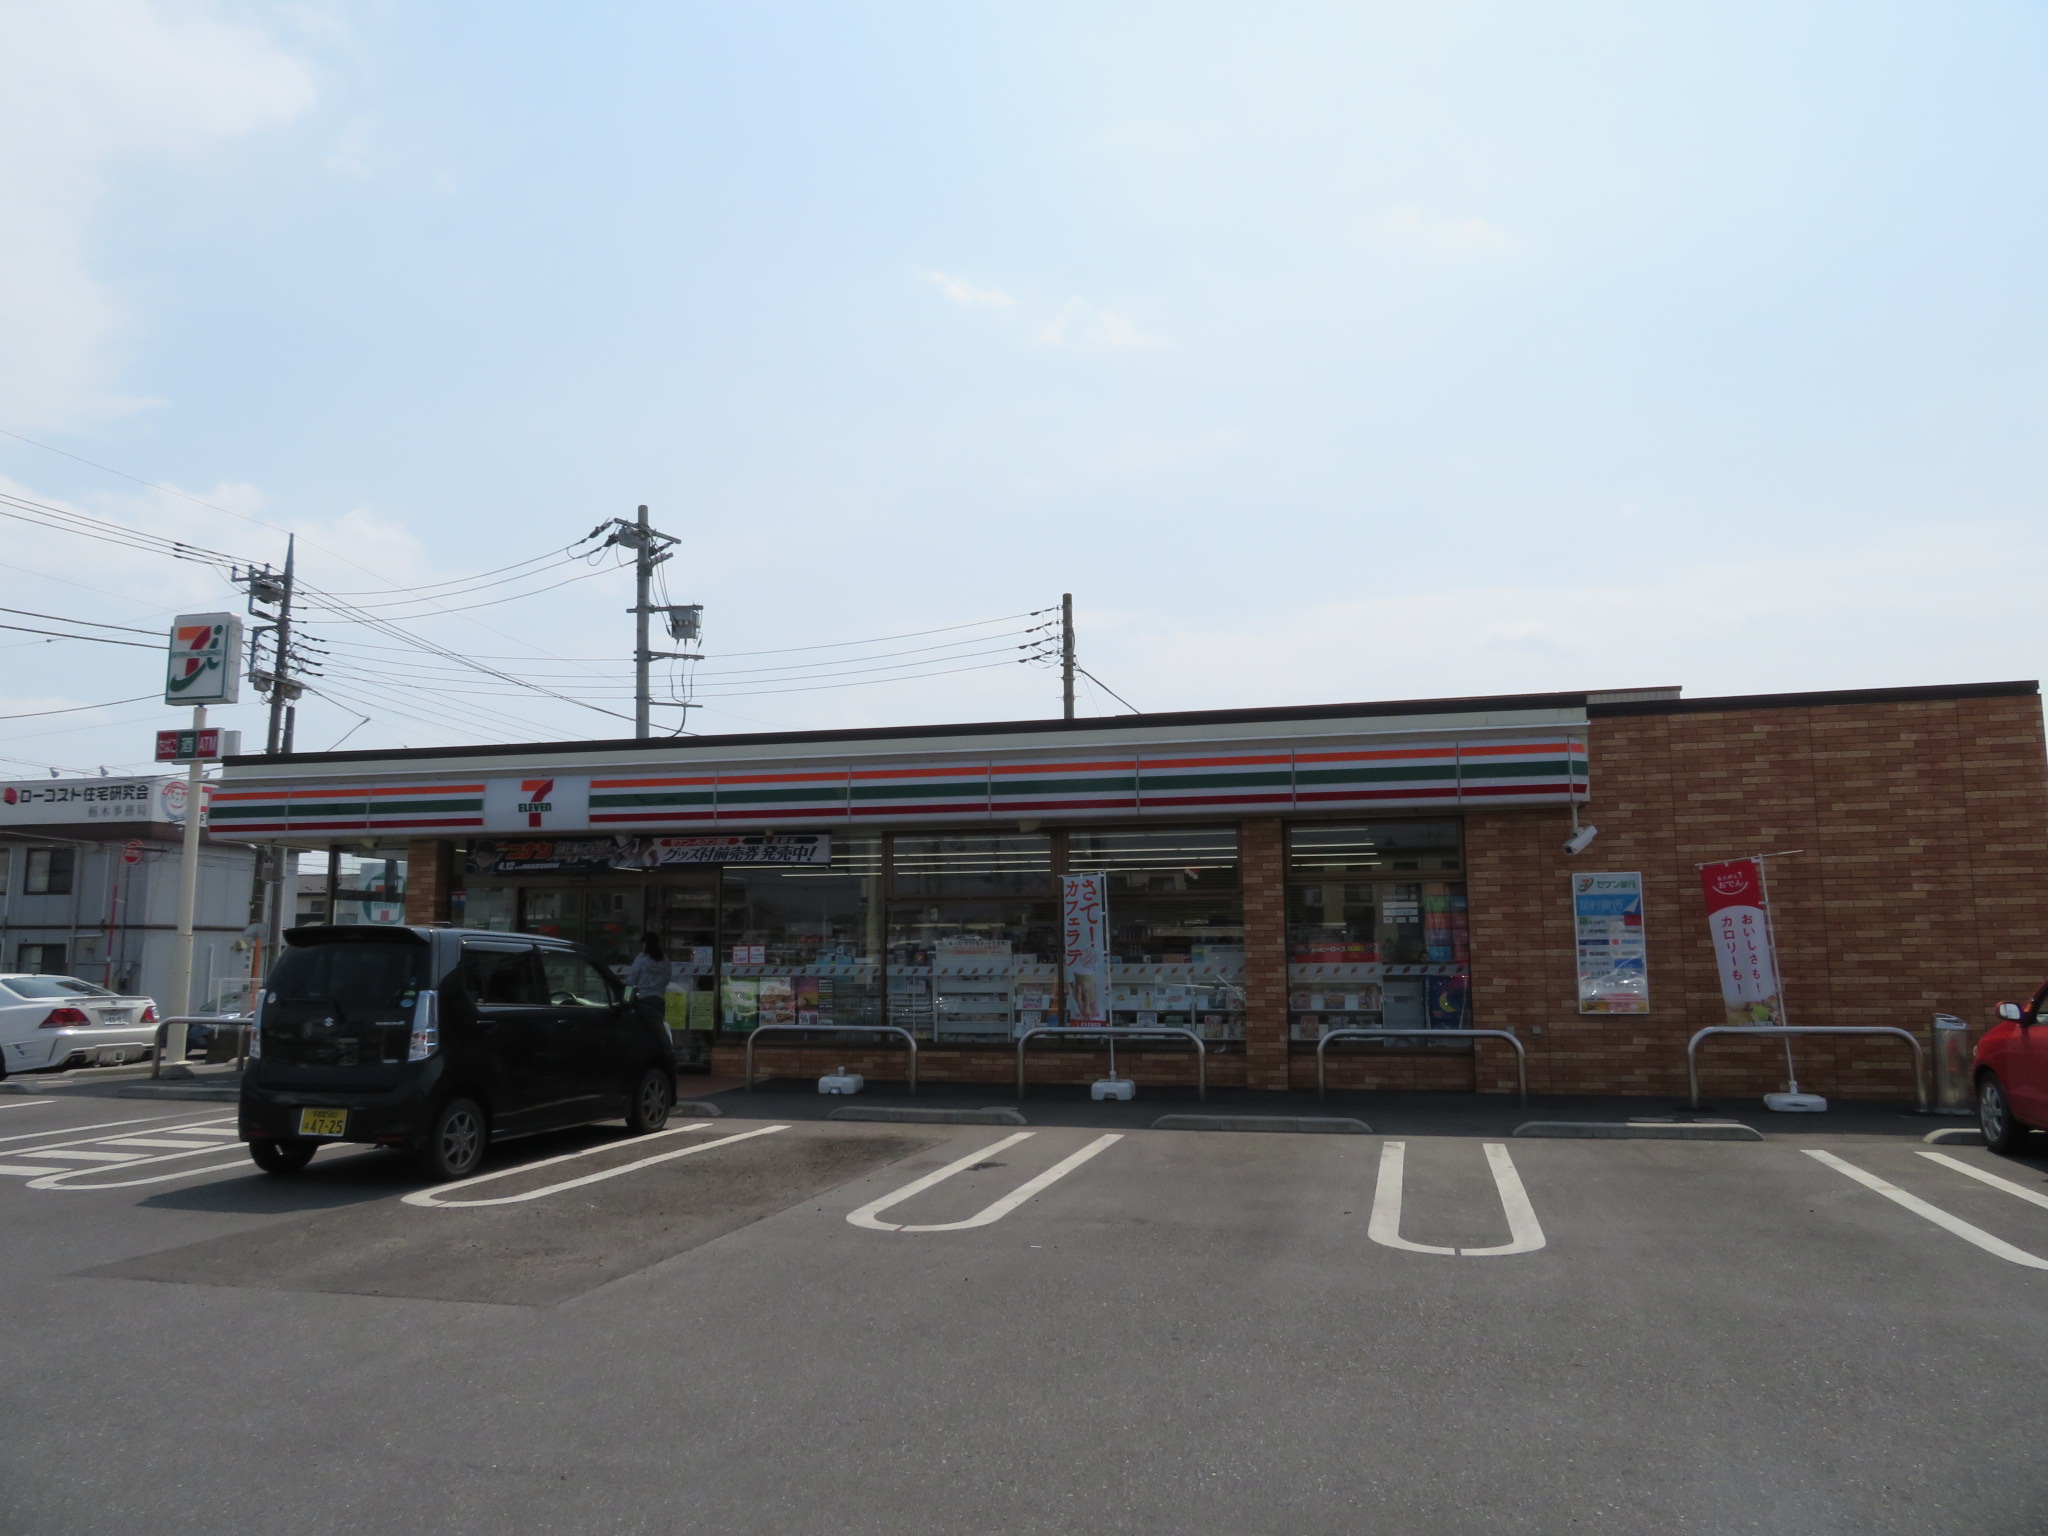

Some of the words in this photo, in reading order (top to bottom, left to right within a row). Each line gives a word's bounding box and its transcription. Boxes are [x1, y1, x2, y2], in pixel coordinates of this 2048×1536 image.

[180, 737, 194, 753] 酒
[198, 735, 217, 752] ATM
[20, 785, 149, 803] ローコスト住宅研究会
[664, 846, 760, 862] グッズ付前売券
[1718, 879, 1744, 889] おでん
[1079, 879, 1099, 948] さて!
[1065, 880, 1083, 966] カフェラテ
[1721, 915, 1742, 994] カロリーも!
[1742, 913, 1760, 993] おいしさも!
[310, 1118, 344, 1134] 47-25
